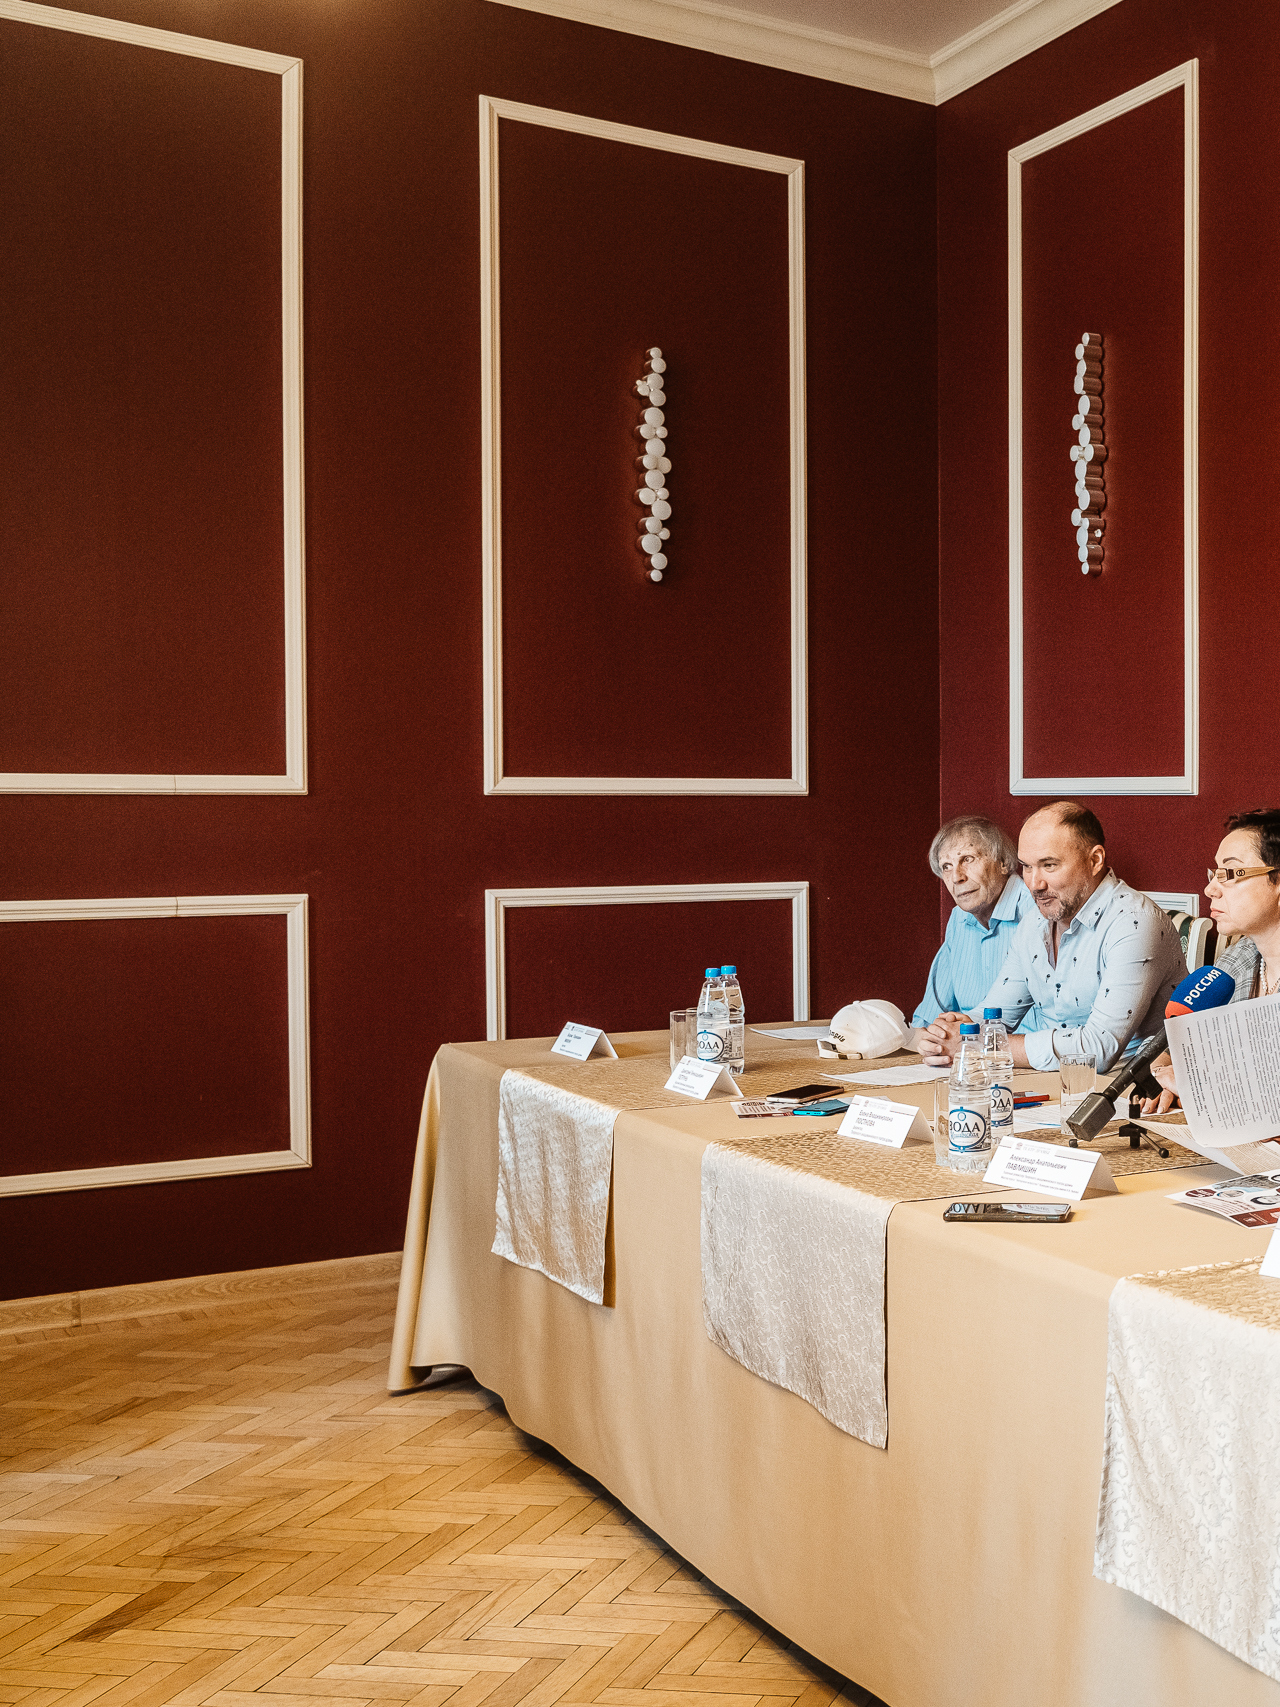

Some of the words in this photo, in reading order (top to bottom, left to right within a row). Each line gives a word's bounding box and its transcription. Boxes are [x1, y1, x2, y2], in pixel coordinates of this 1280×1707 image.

[1183, 969, 1222, 1006] РОССИЯ
[698, 1041, 720, 1050] ОДА
[991, 1097, 1011, 1109] ОДА
[1005, 1162, 1038, 1174] ПАВЛИШИН
[1009, 1154, 1036, 1166] Александр
[1036, 1159, 1068, 1170] Анатольевич
